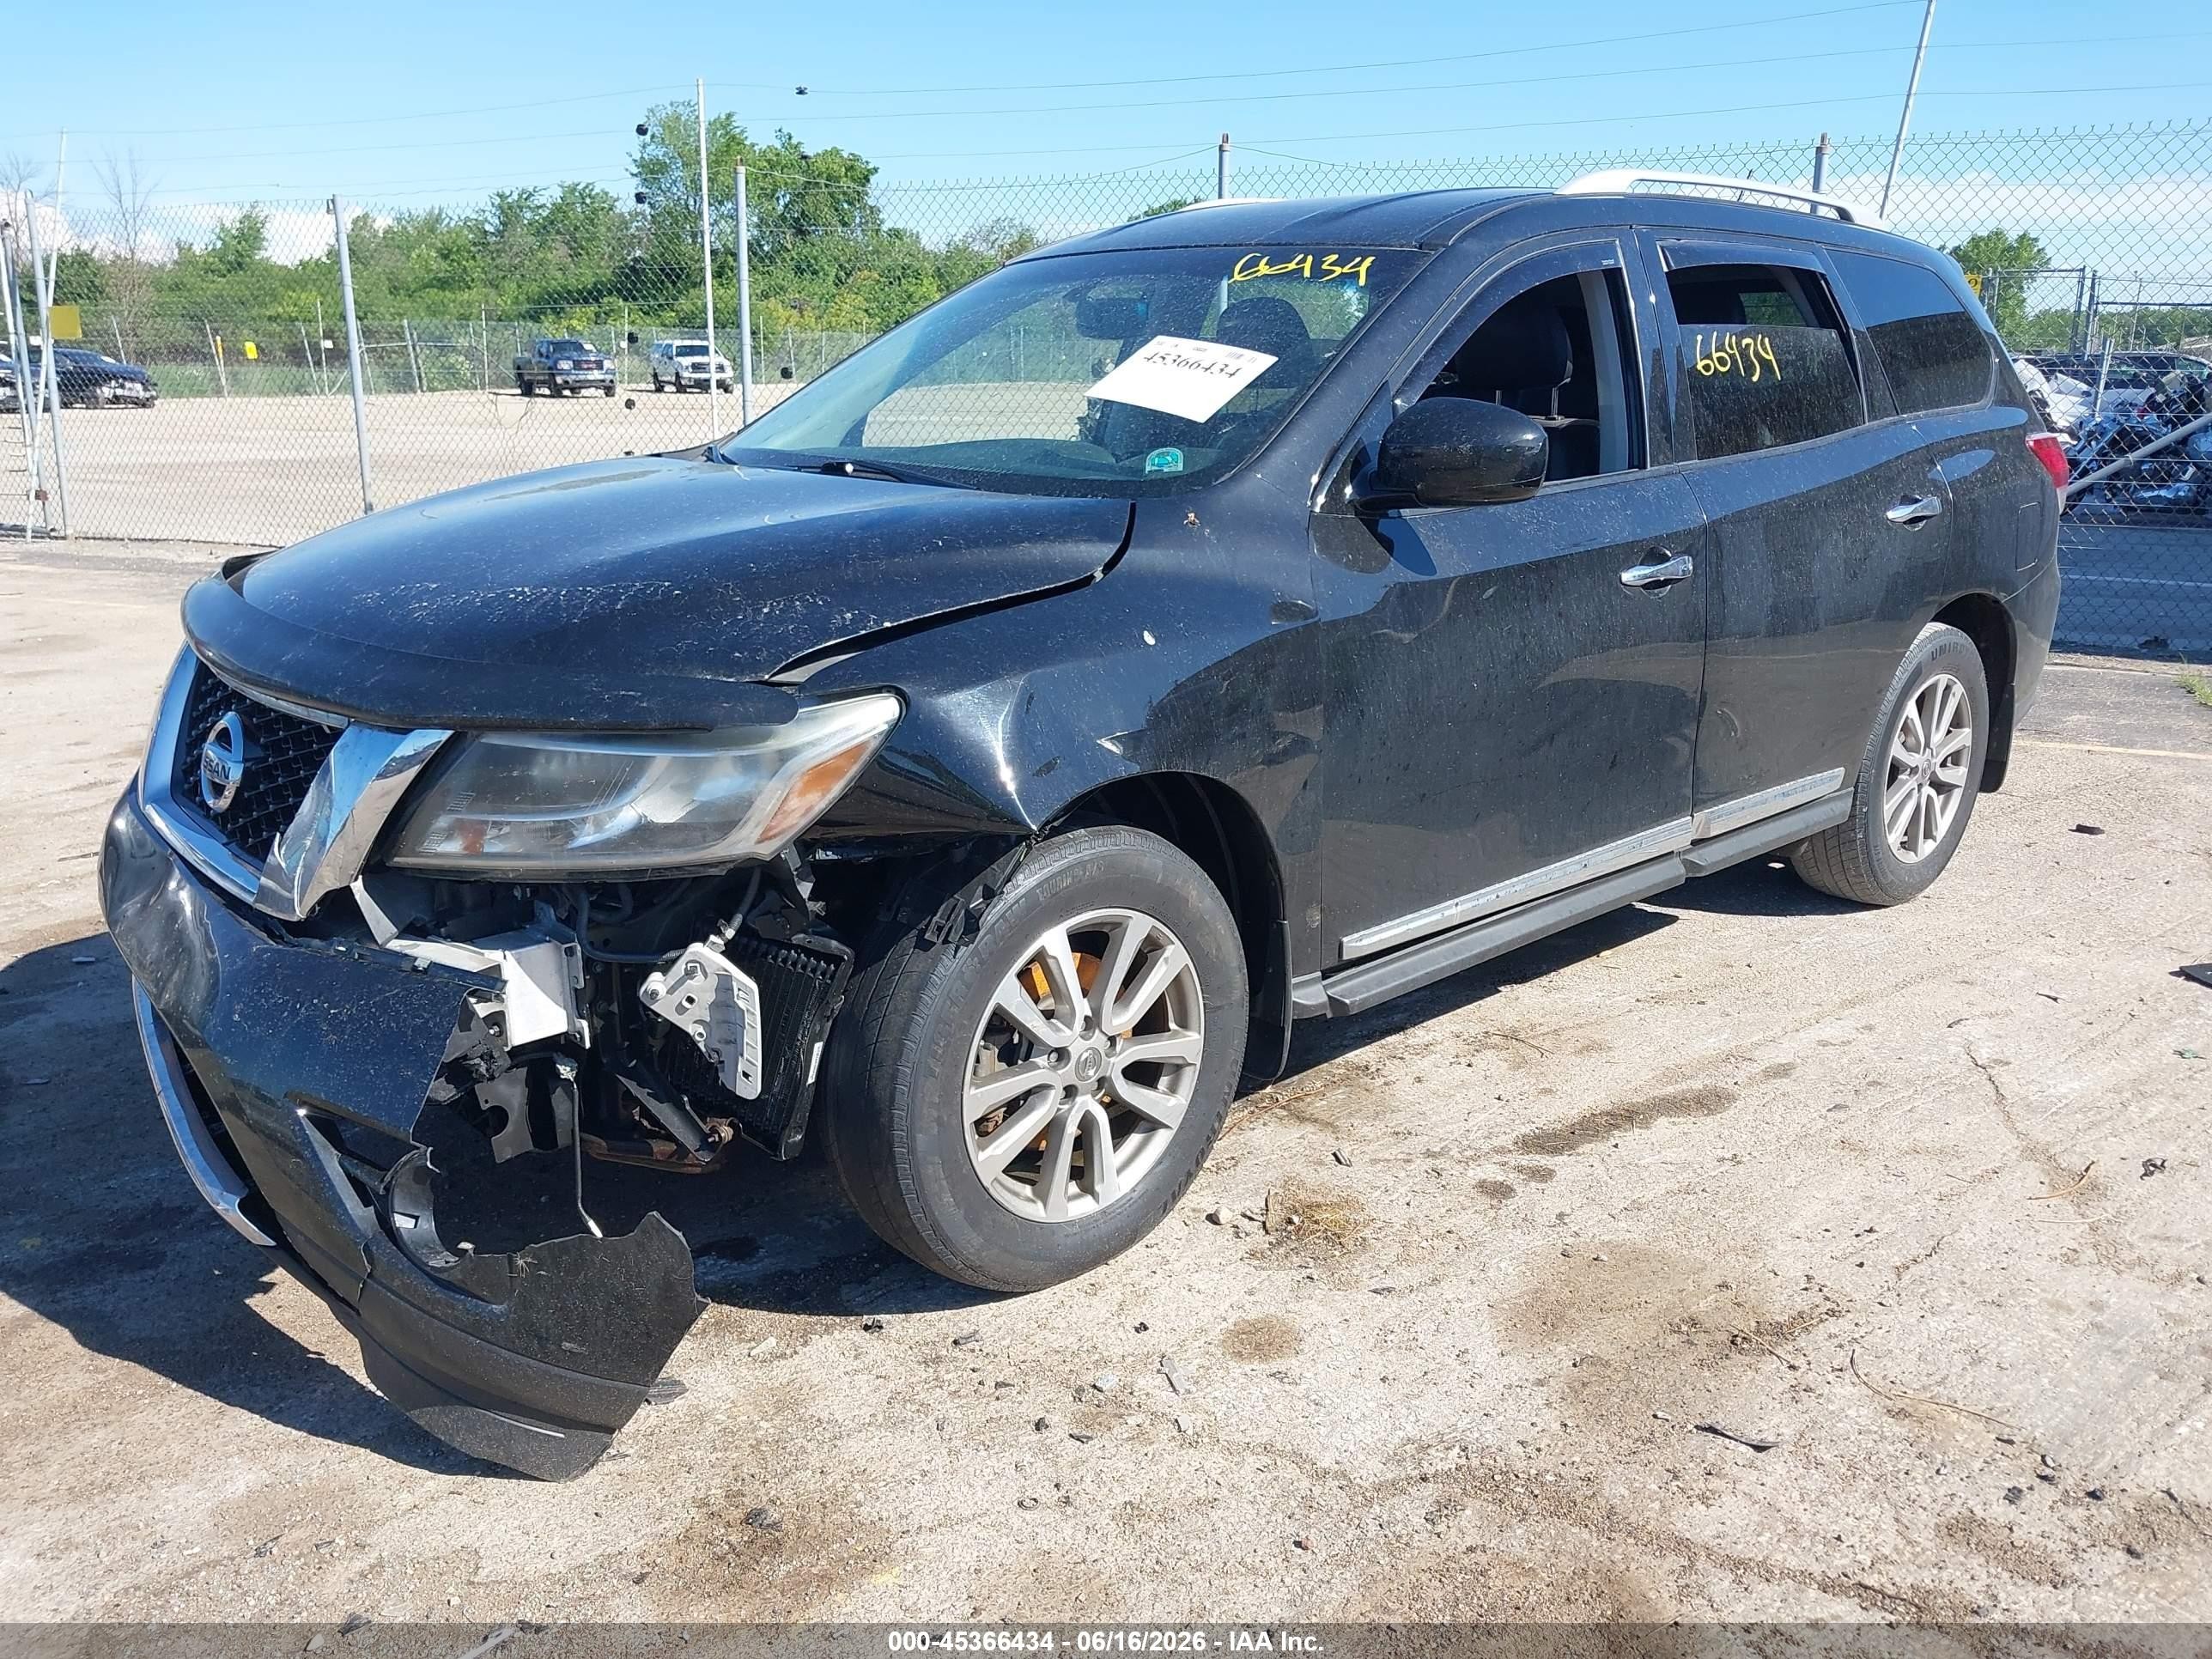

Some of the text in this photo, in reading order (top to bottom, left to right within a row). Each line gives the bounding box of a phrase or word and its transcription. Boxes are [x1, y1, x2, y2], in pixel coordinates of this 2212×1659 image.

[1228, 252, 1376, 287] 66434
[1143, 351, 1243, 379] 45366434
[1696, 331, 1782, 382] 66434
